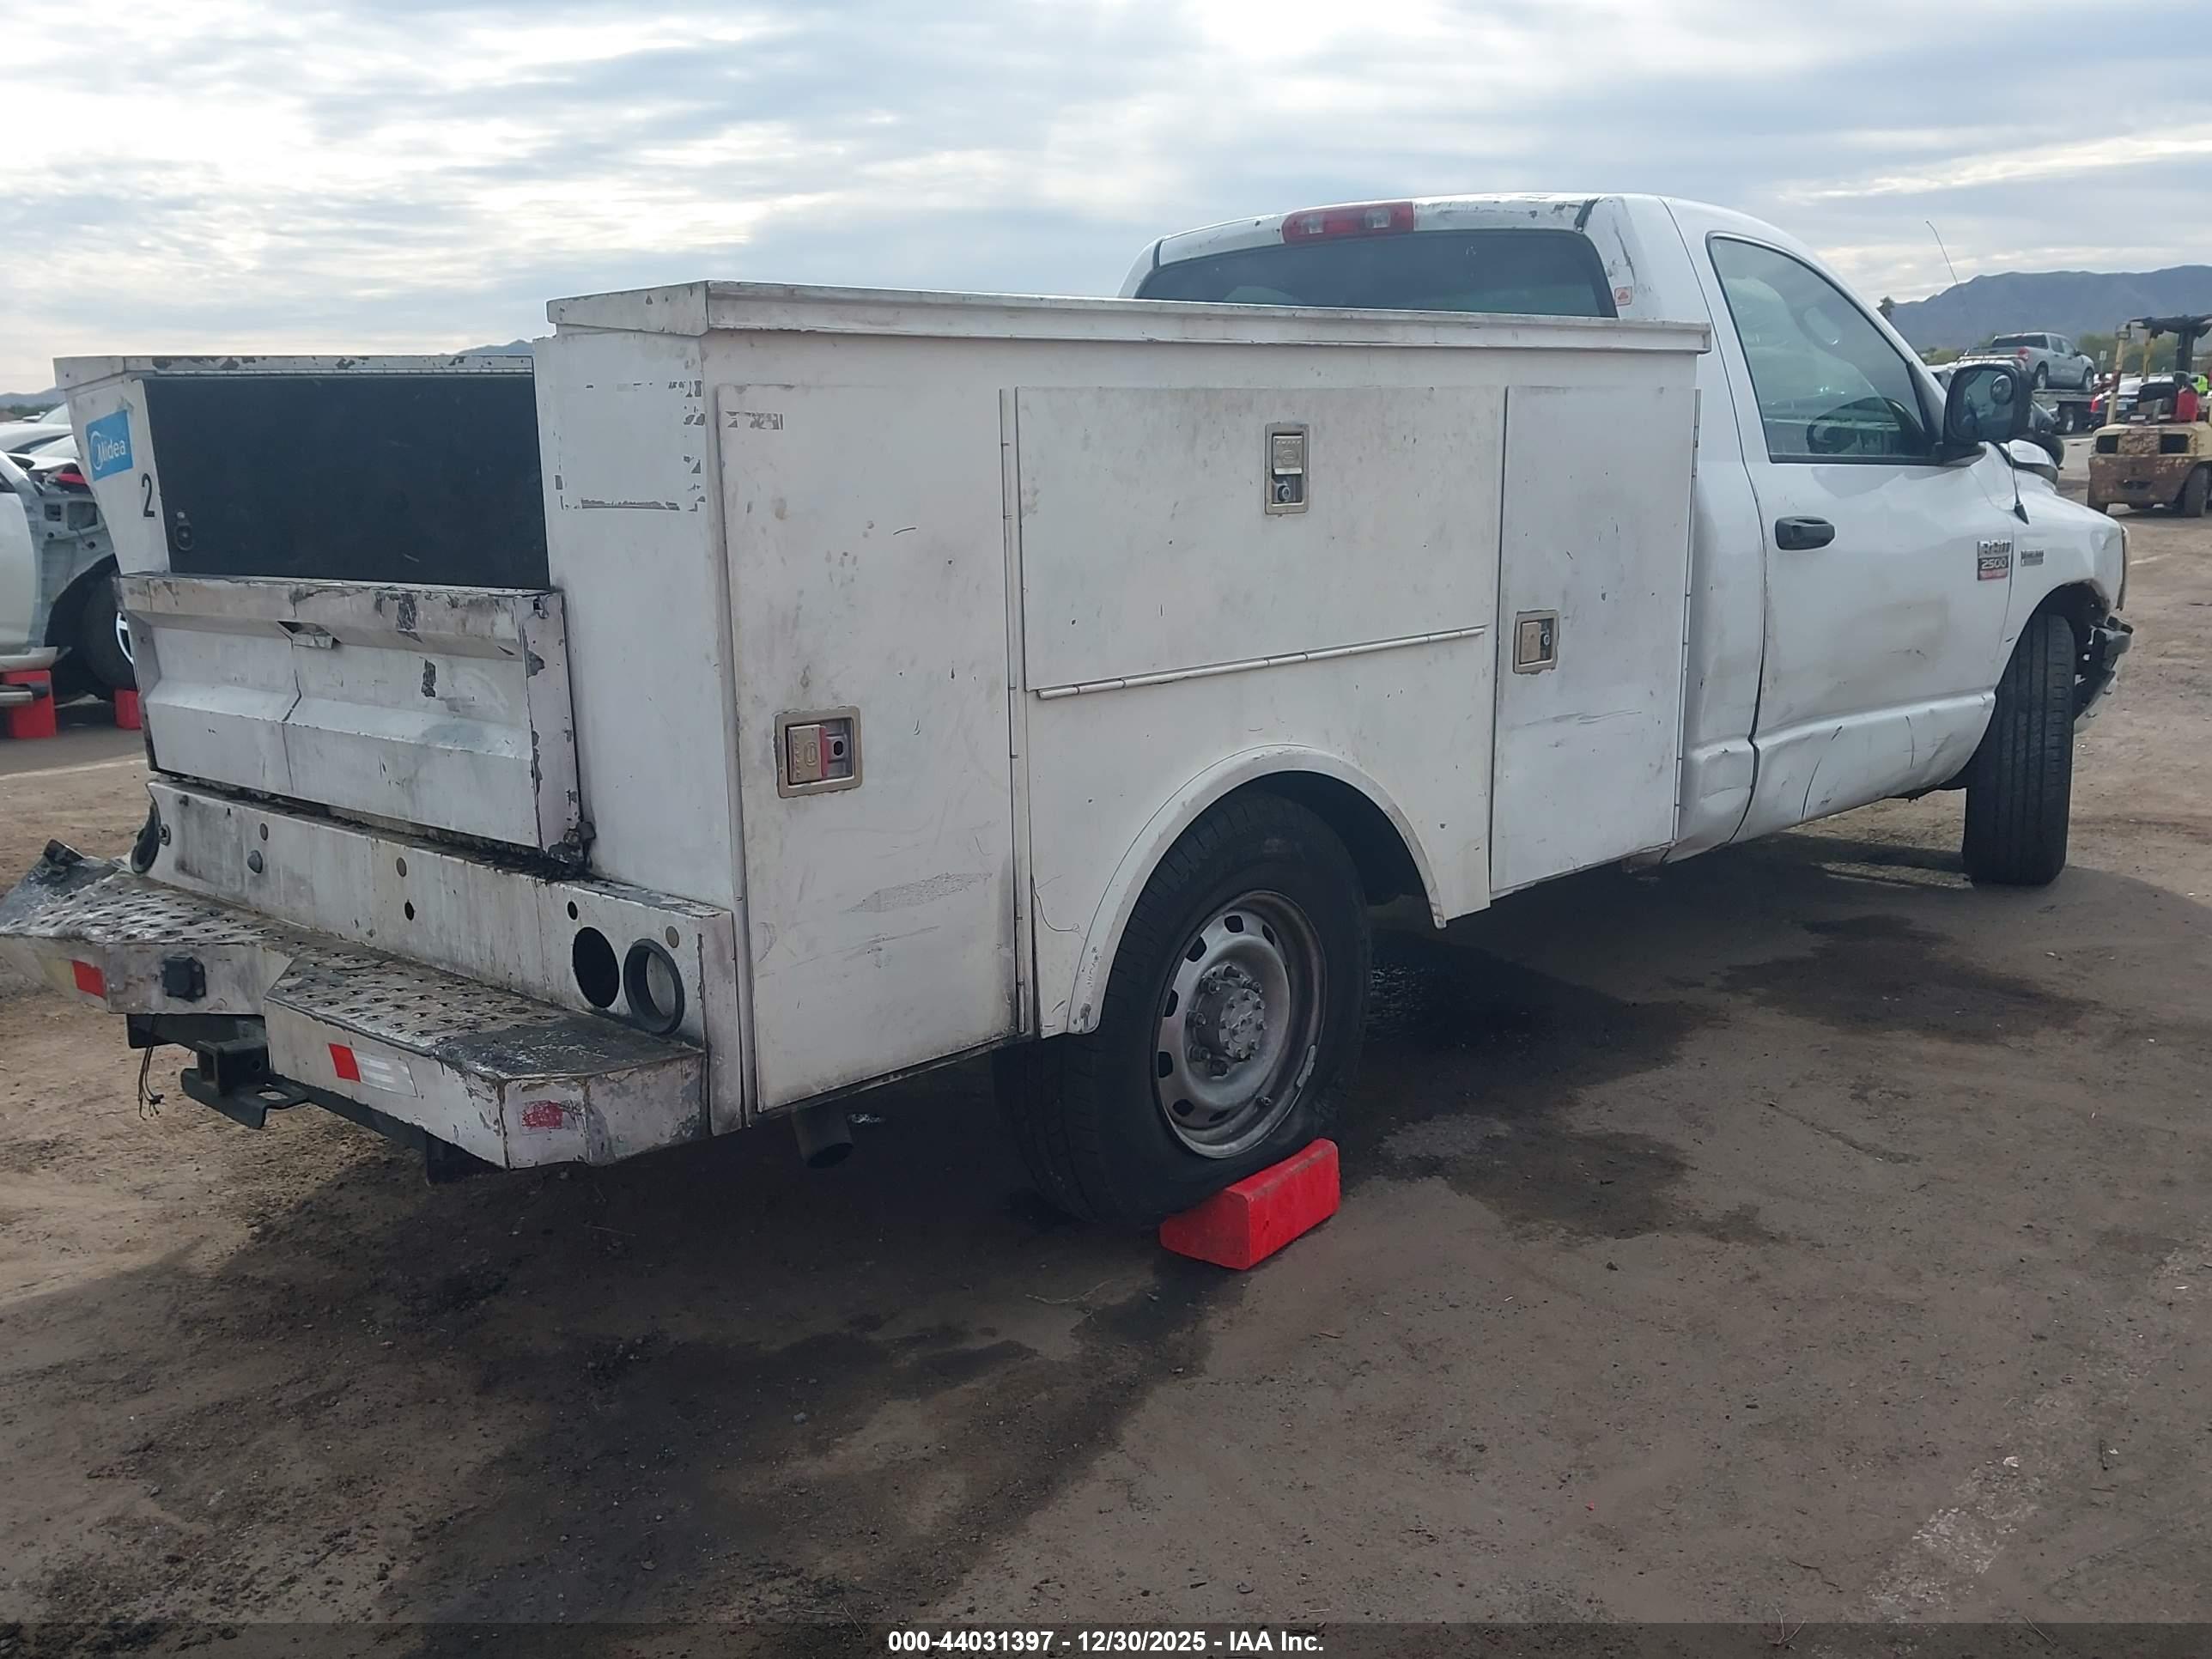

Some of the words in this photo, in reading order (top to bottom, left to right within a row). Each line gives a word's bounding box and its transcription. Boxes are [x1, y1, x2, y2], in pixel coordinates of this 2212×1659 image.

[90, 430, 126, 471] Midea
[142, 473, 155, 518] 2
[1981, 558, 2007, 570] 2500
